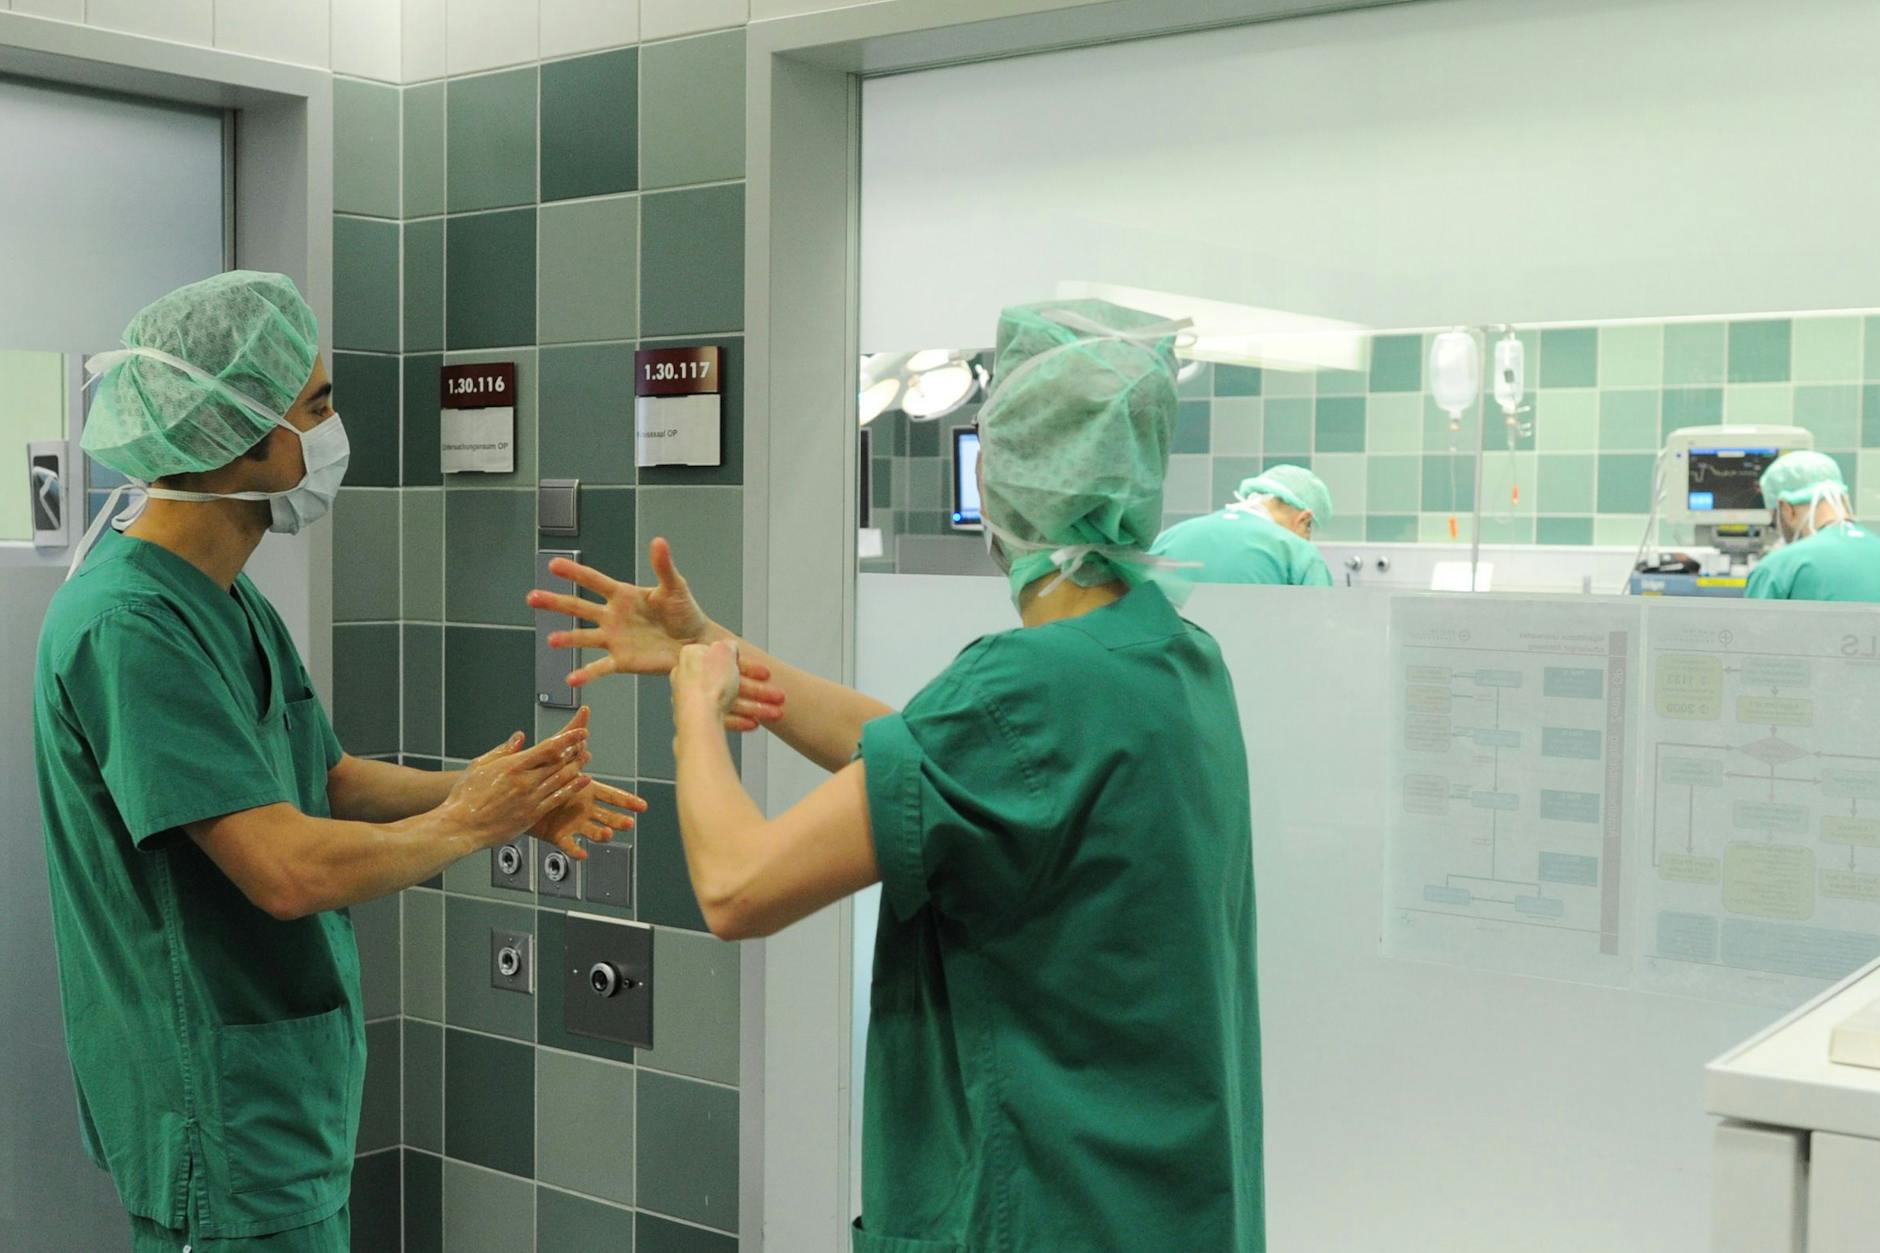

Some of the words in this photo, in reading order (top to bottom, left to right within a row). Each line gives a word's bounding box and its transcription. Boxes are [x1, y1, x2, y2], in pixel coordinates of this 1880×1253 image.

[644, 361, 711, 381] 1.30.117
[448, 376, 506, 395] 1.30.116
[667, 428, 679, 438] OP
[497, 442, 509, 450] OP
